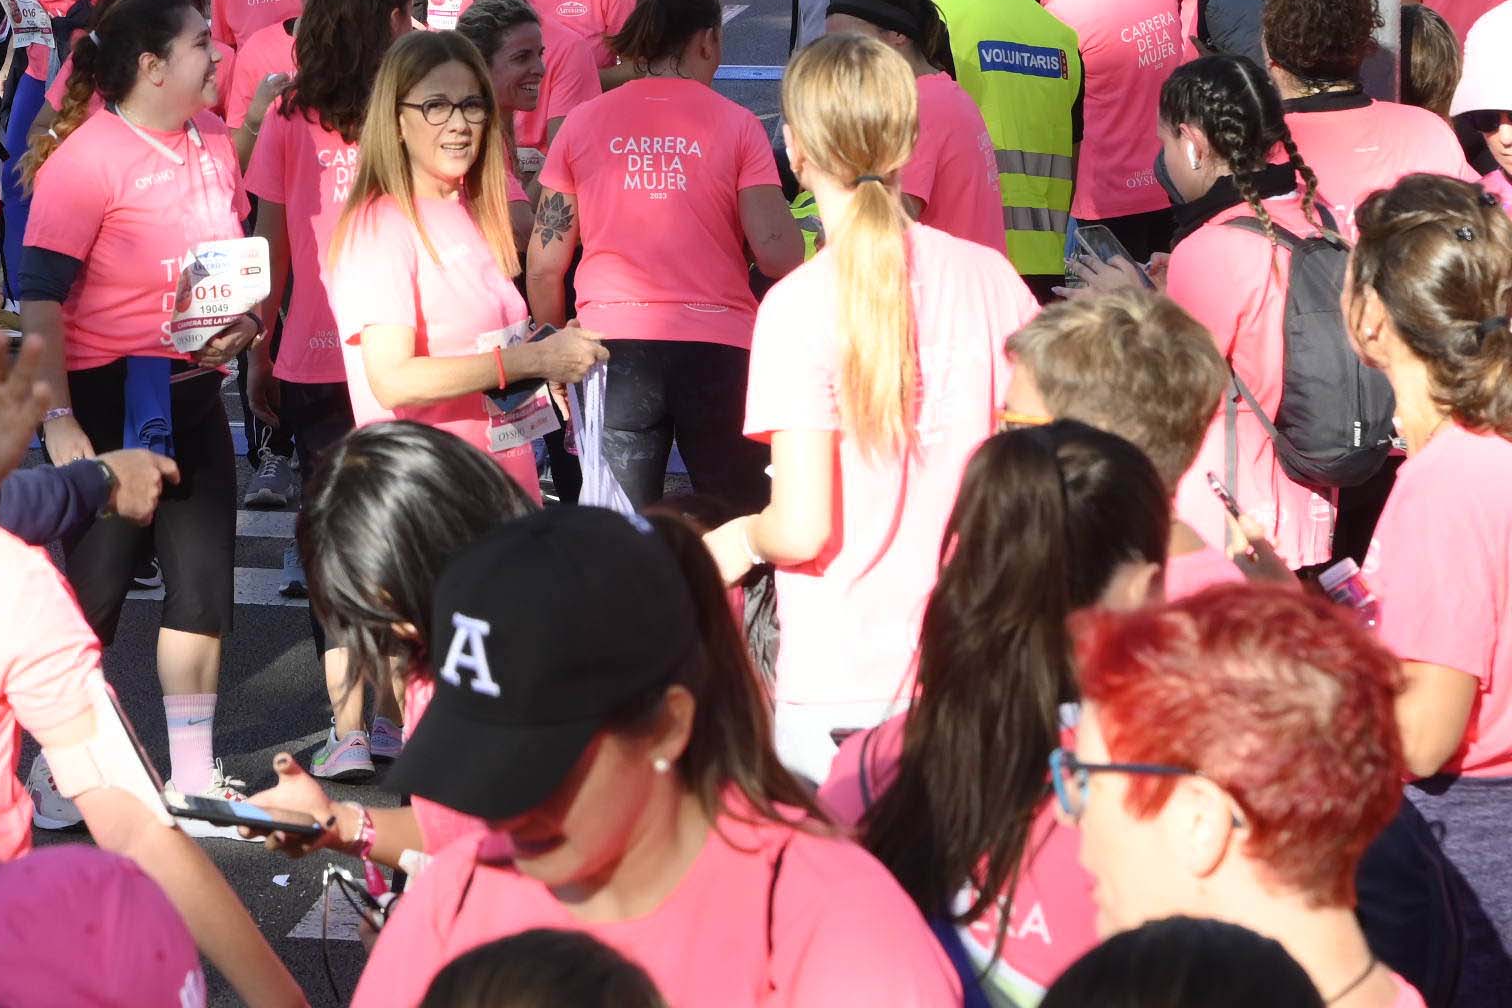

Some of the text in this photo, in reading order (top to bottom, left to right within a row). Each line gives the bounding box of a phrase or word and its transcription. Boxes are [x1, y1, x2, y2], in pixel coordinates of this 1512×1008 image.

[22, 7, 36, 18] 016
[1120, 10, 1176, 43] CARRERA
[1137, 30, 1172, 53] DE LA
[981, 47, 1060, 71] VOLUNTARIS
[1137, 41, 1177, 69] MUJER
[609, 135, 703, 159] CARRERA
[627, 154, 684, 174] DE LA
[623, 172, 689, 193] MUJER
[649, 191, 668, 200] 2023
[195, 284, 232, 300] 016
[199, 304, 229, 315] 19049
[202, 317, 213, 326] DE
[213, 316, 224, 325] LA
[497, 427, 526, 443] OYSHO
[439, 611, 502, 698] A
